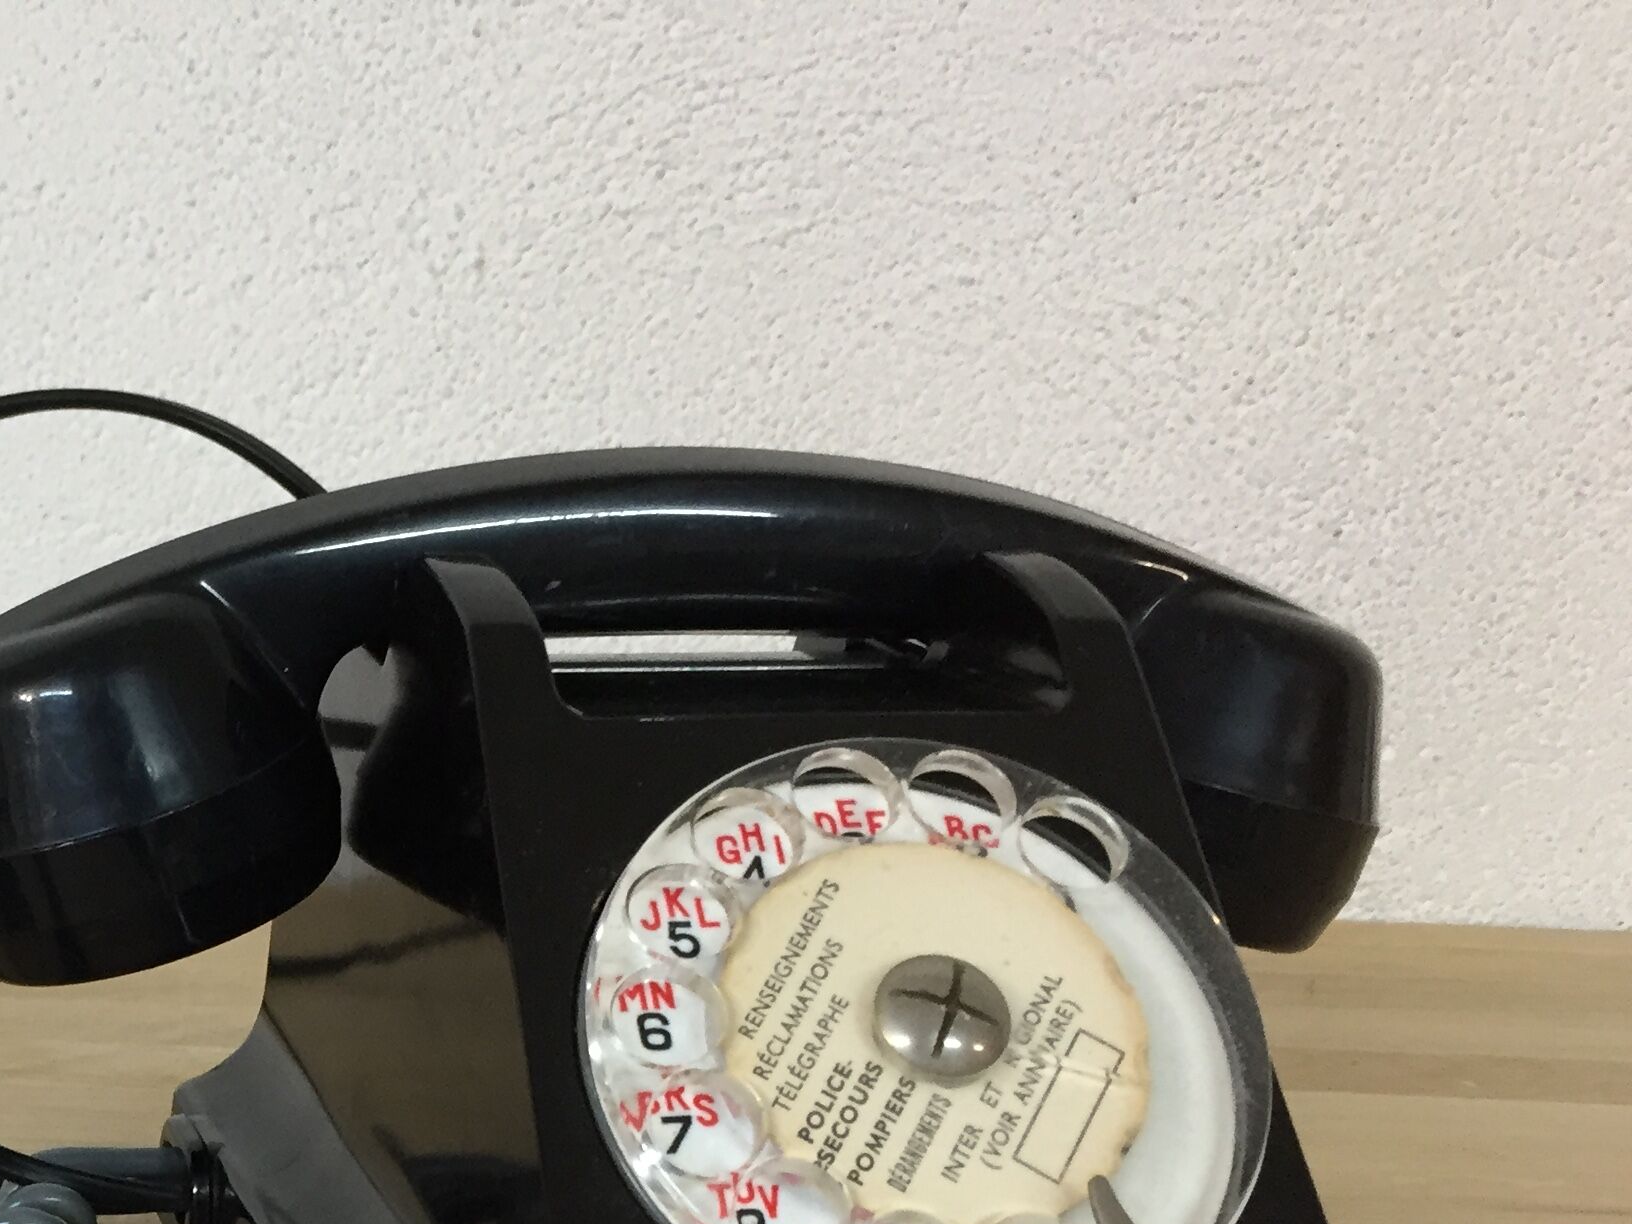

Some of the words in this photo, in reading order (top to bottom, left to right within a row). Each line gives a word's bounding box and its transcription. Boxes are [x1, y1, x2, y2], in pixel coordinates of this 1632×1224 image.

[715, 822, 786, 866] GHI
[640, 887, 721, 932] JKL
[668, 920, 701, 959] 5
[738, 878, 841, 1041] RENSEIGNEMENTS
[617, 980, 677, 1013] MN
[753, 938, 844, 1082] RÉCLAMATIONS
[637, 1012, 672, 1050] 6
[772, 993, 850, 1113] TÉLÉGRAPHE
[797, 1060, 854, 1145] POLICE-
[661, 1115, 693, 1155] 7
[847, 1075, 917, 1187] POMPIERS
[941, 1123, 984, 1184] INTER
[980, 1080, 1003, 1109] ET
[980, 1110, 1022, 1171] (VOIR
[707, 1172, 780, 1220] TUV
